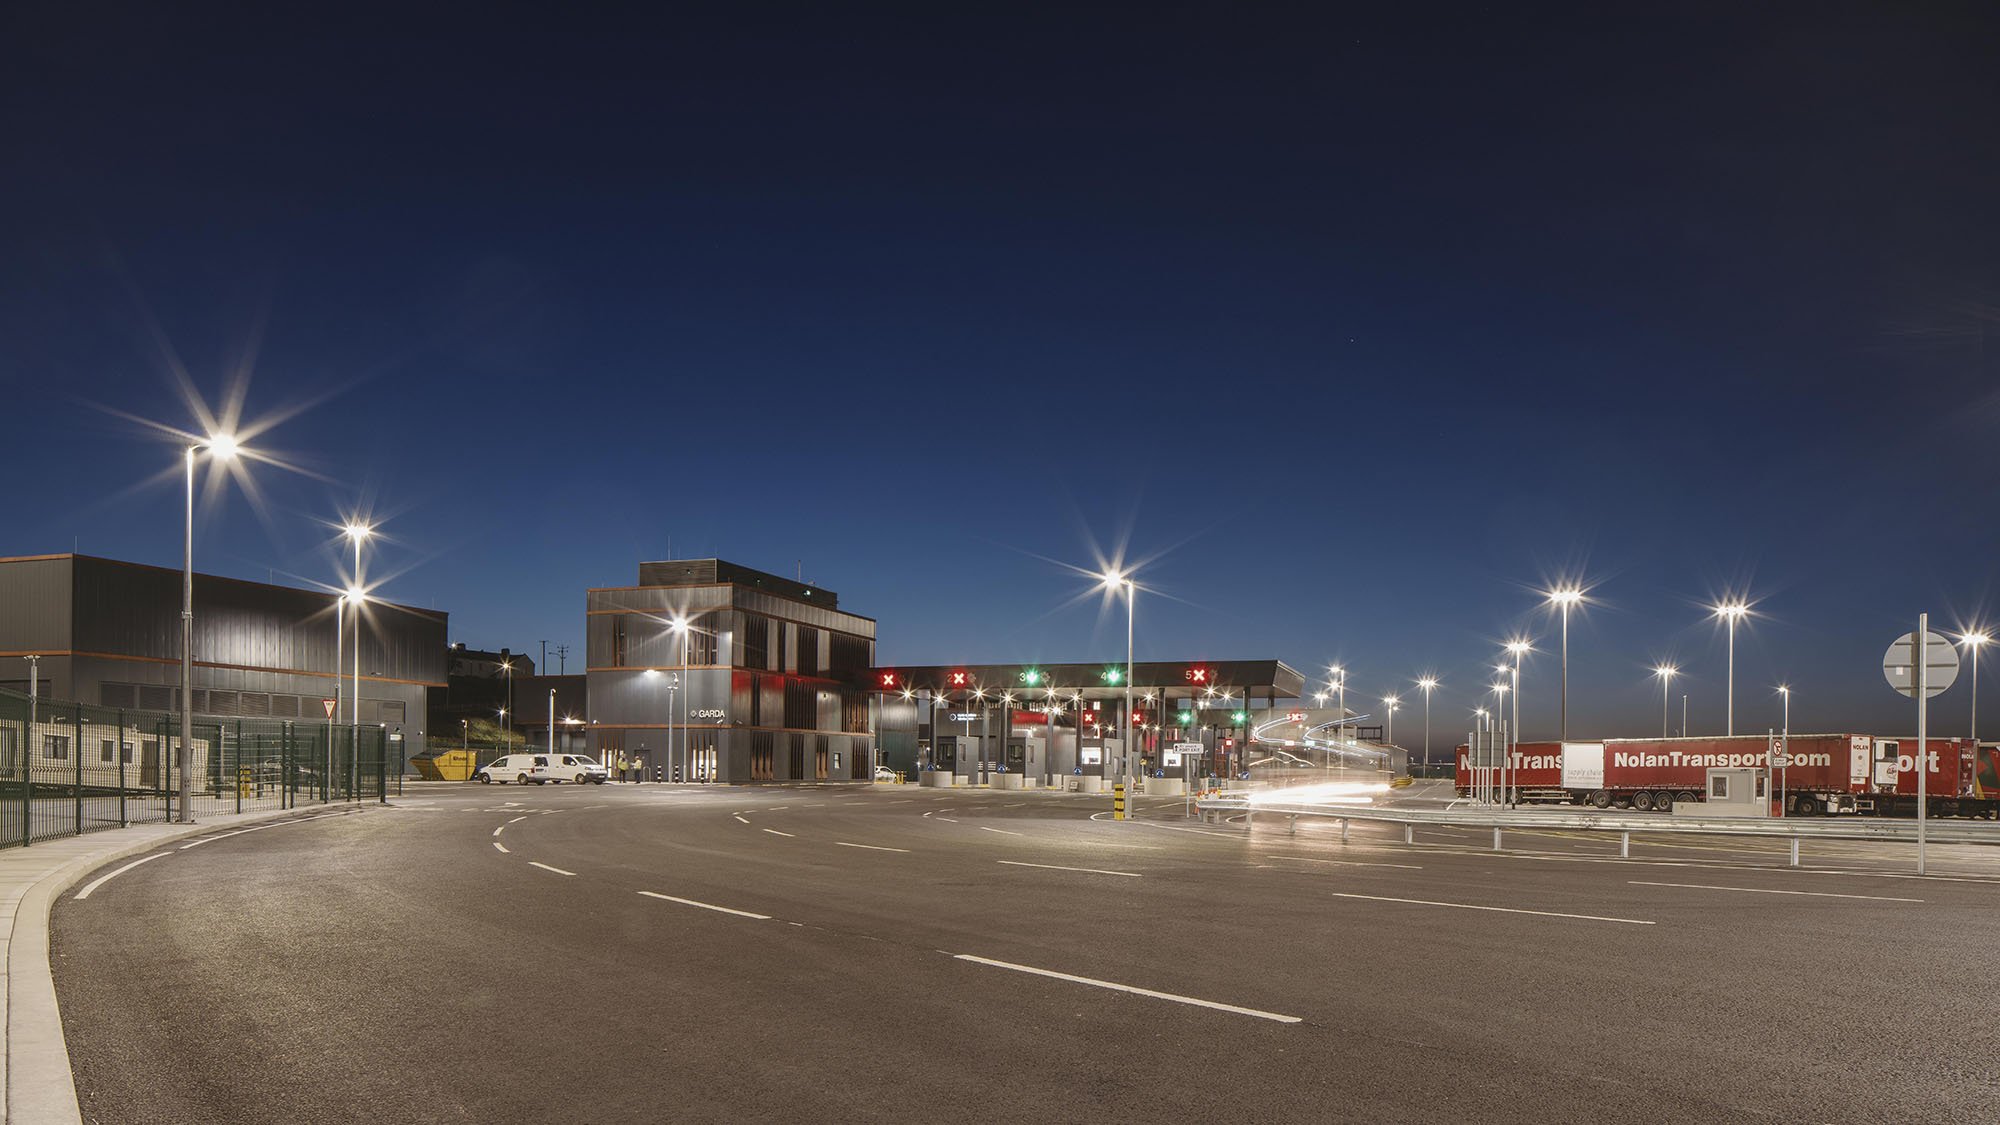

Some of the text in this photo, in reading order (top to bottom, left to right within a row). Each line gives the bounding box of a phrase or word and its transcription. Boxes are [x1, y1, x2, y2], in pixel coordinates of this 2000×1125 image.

[1019, 672, 1026, 682] 3
[1100, 671, 1107, 681] 4
[1185, 670, 1192, 680] 5
[698, 709, 725, 718] GARDA
[1614, 751, 1831, 768] NolanTransportcom
